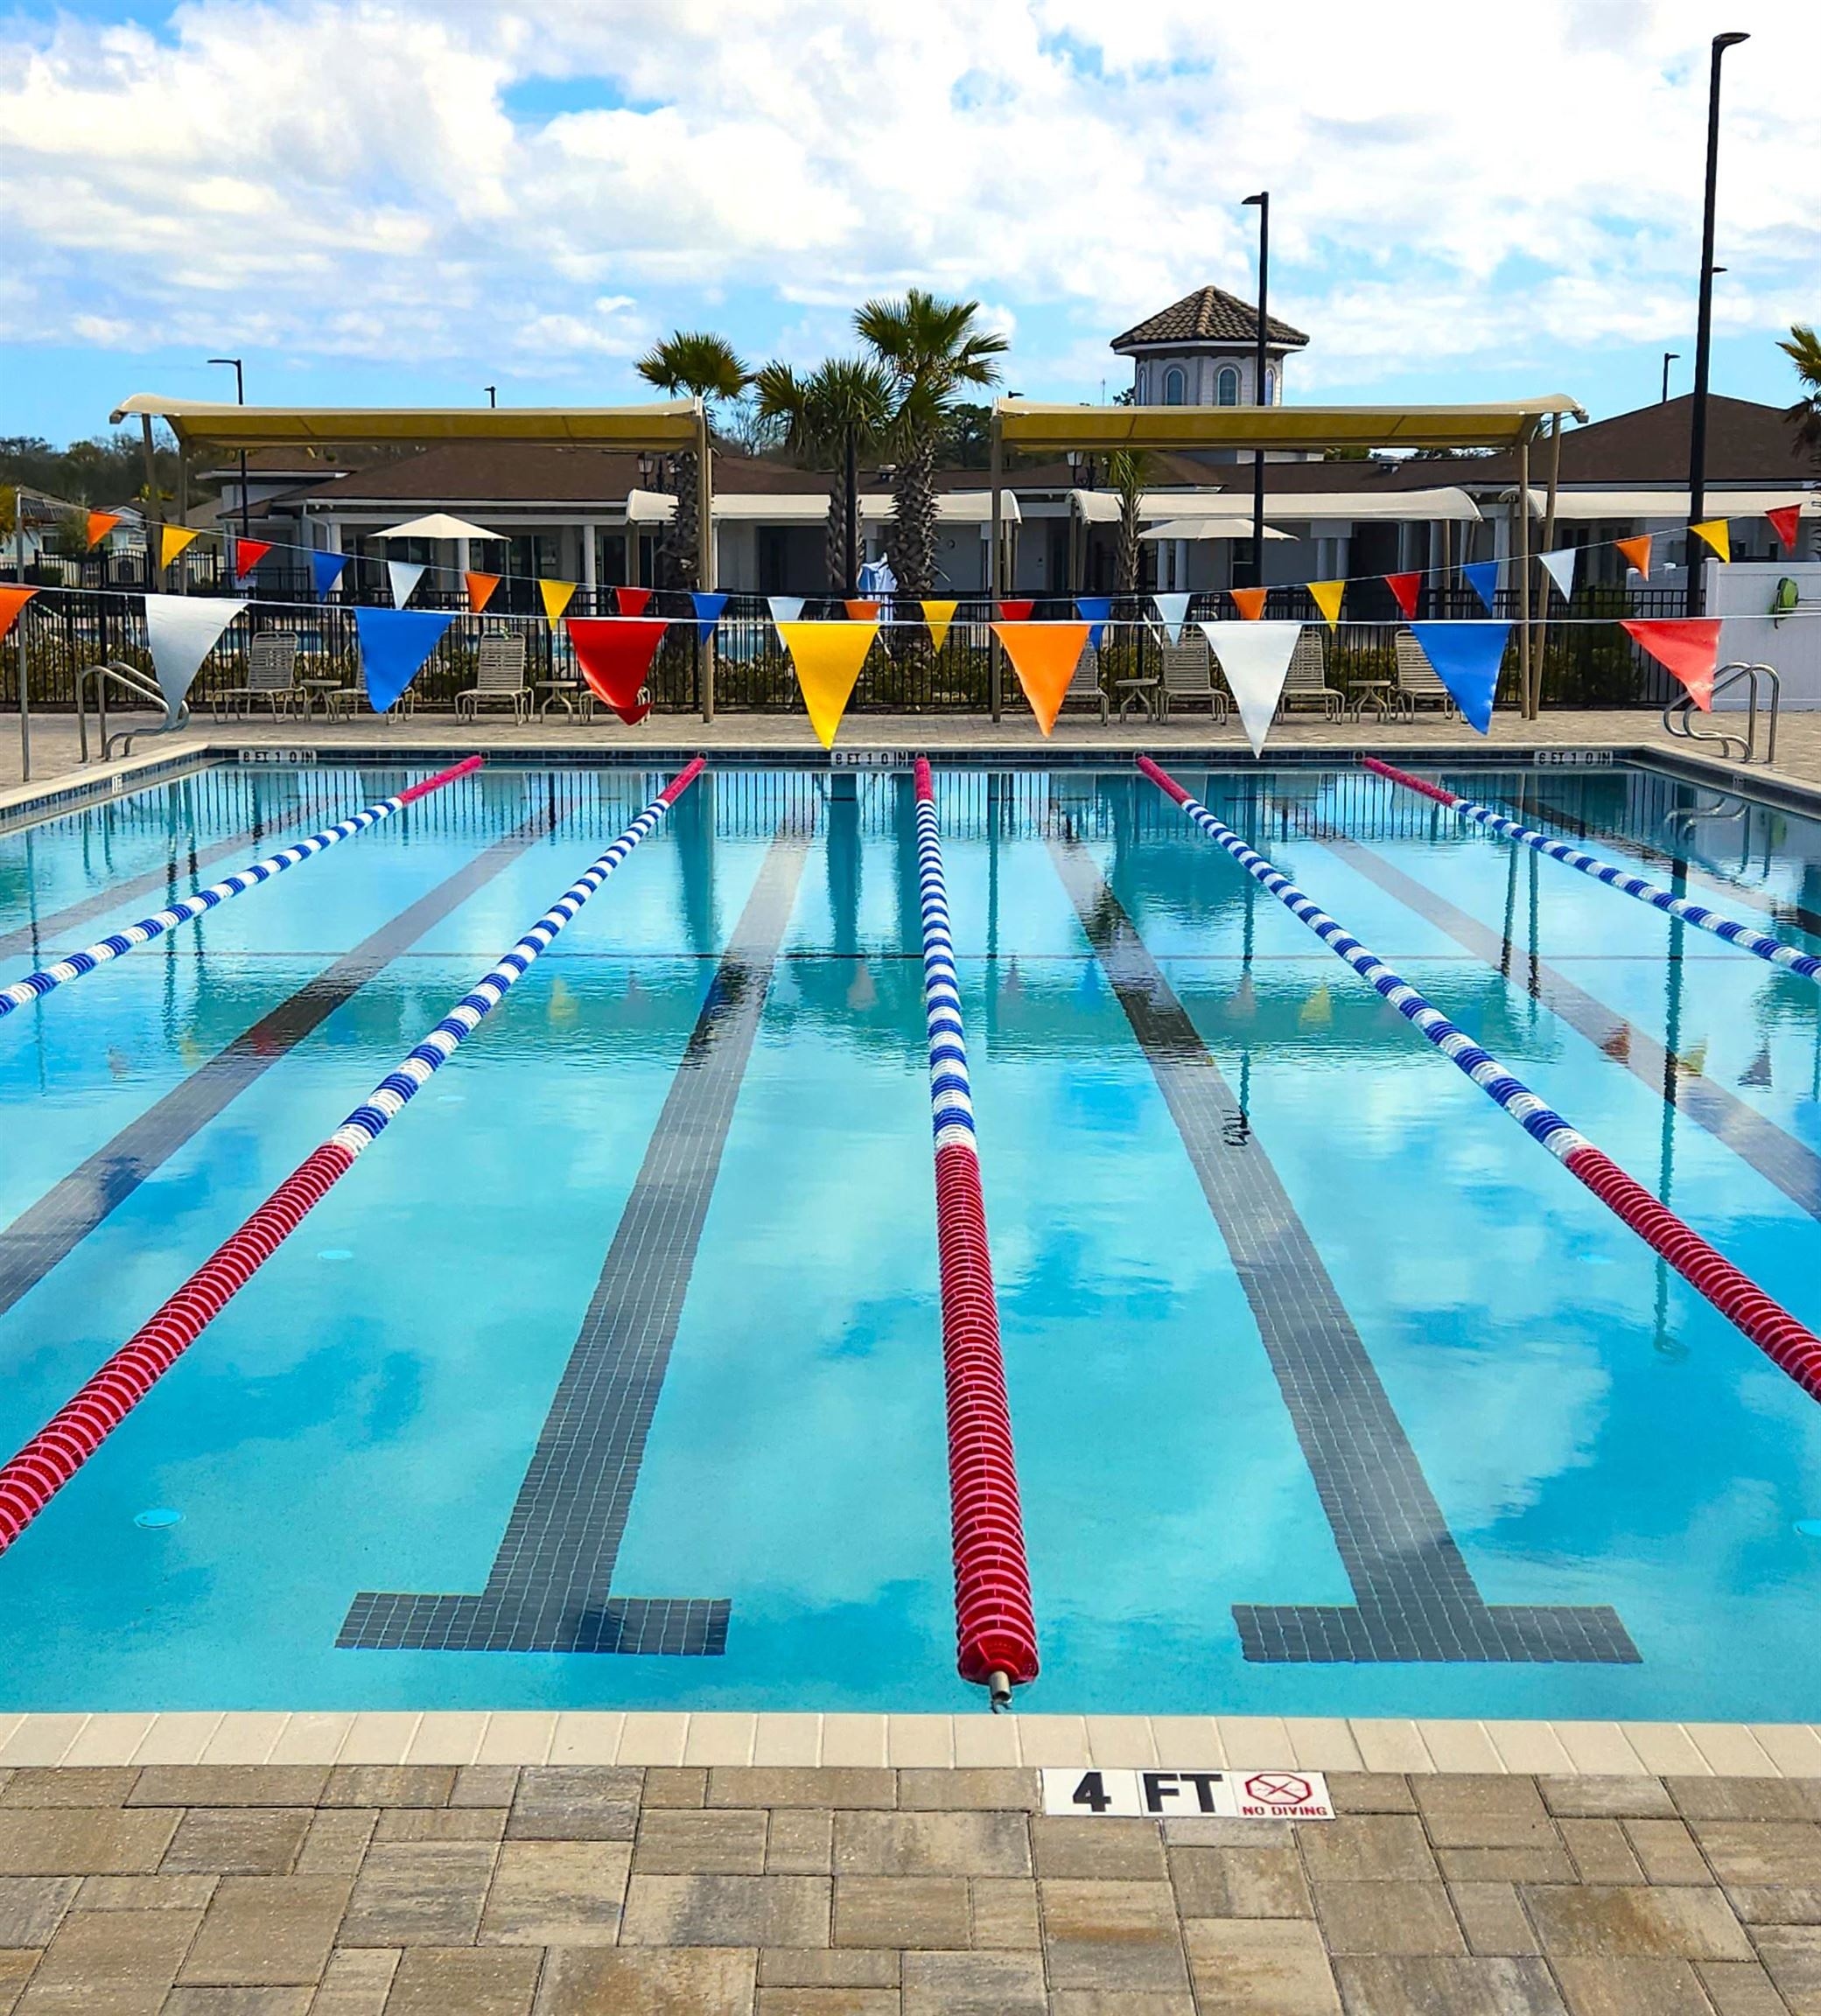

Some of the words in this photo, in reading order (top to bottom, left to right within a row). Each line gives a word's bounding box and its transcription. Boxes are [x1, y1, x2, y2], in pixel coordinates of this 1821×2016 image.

[1072, 1771, 1112, 1812] 4
[1142, 1773, 1224, 1813] FT
[1242, 1806, 1265, 1816] NO
[1271, 1806, 1328, 1816] DIVING
